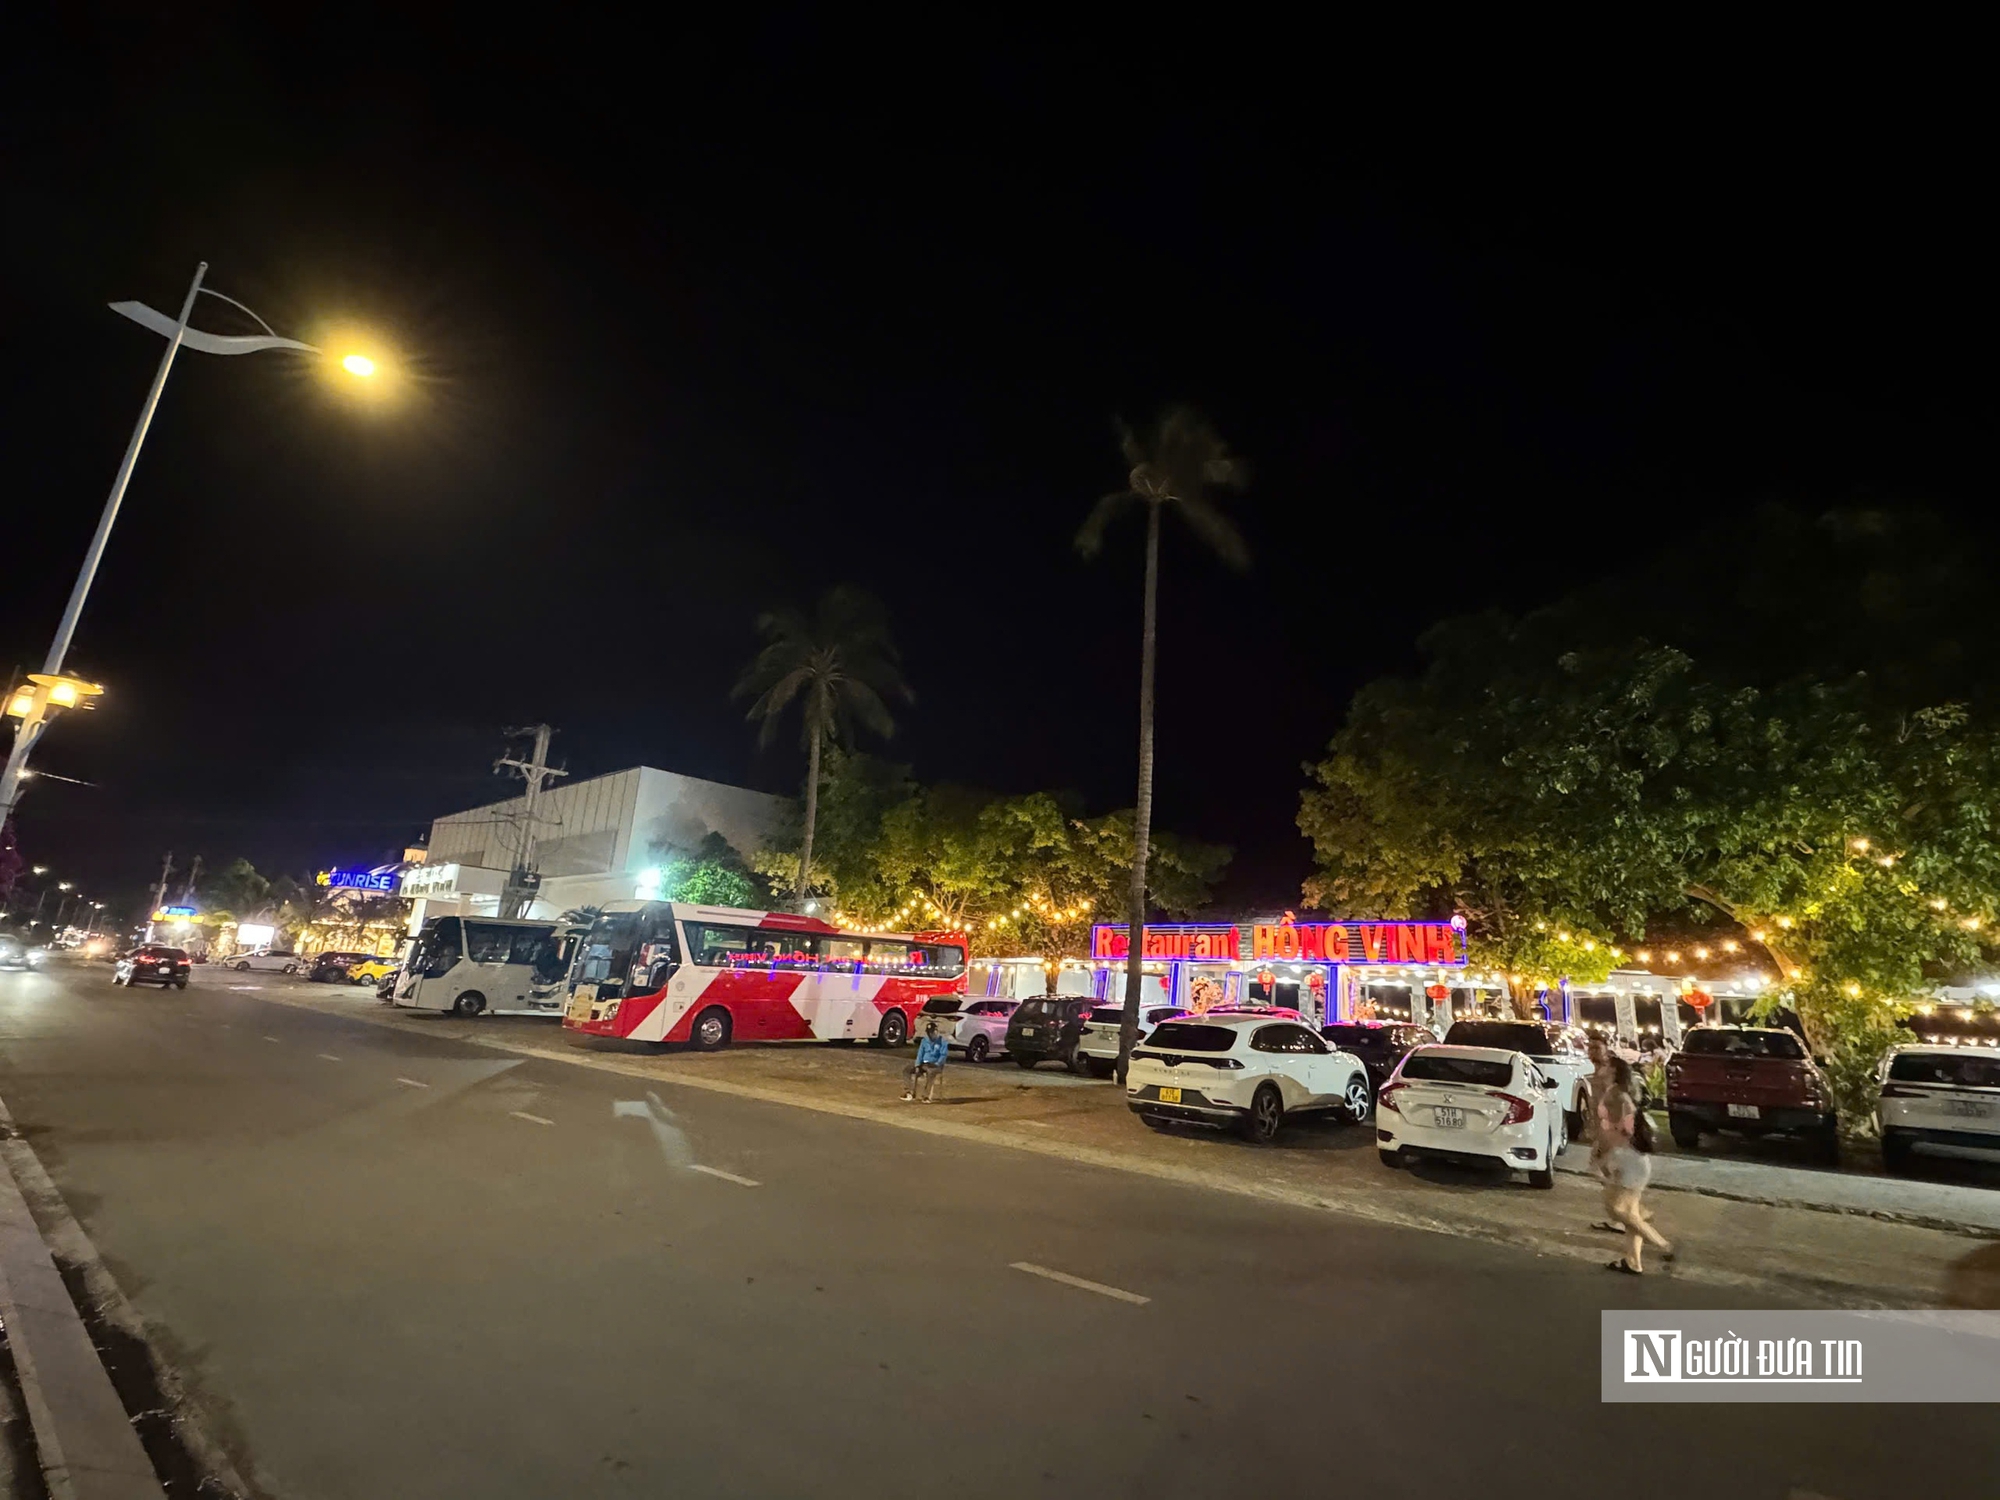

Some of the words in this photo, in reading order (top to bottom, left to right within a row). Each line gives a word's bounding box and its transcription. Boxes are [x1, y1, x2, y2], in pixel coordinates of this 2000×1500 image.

[1095, 925, 1241, 961] Retaurant
[1253, 910, 1349, 962] HỒNG
[1359, 924, 1455, 963] VINH
[1441, 1106, 1457, 1117] 51H
[1435, 1115, 1463, 1127] 51680
